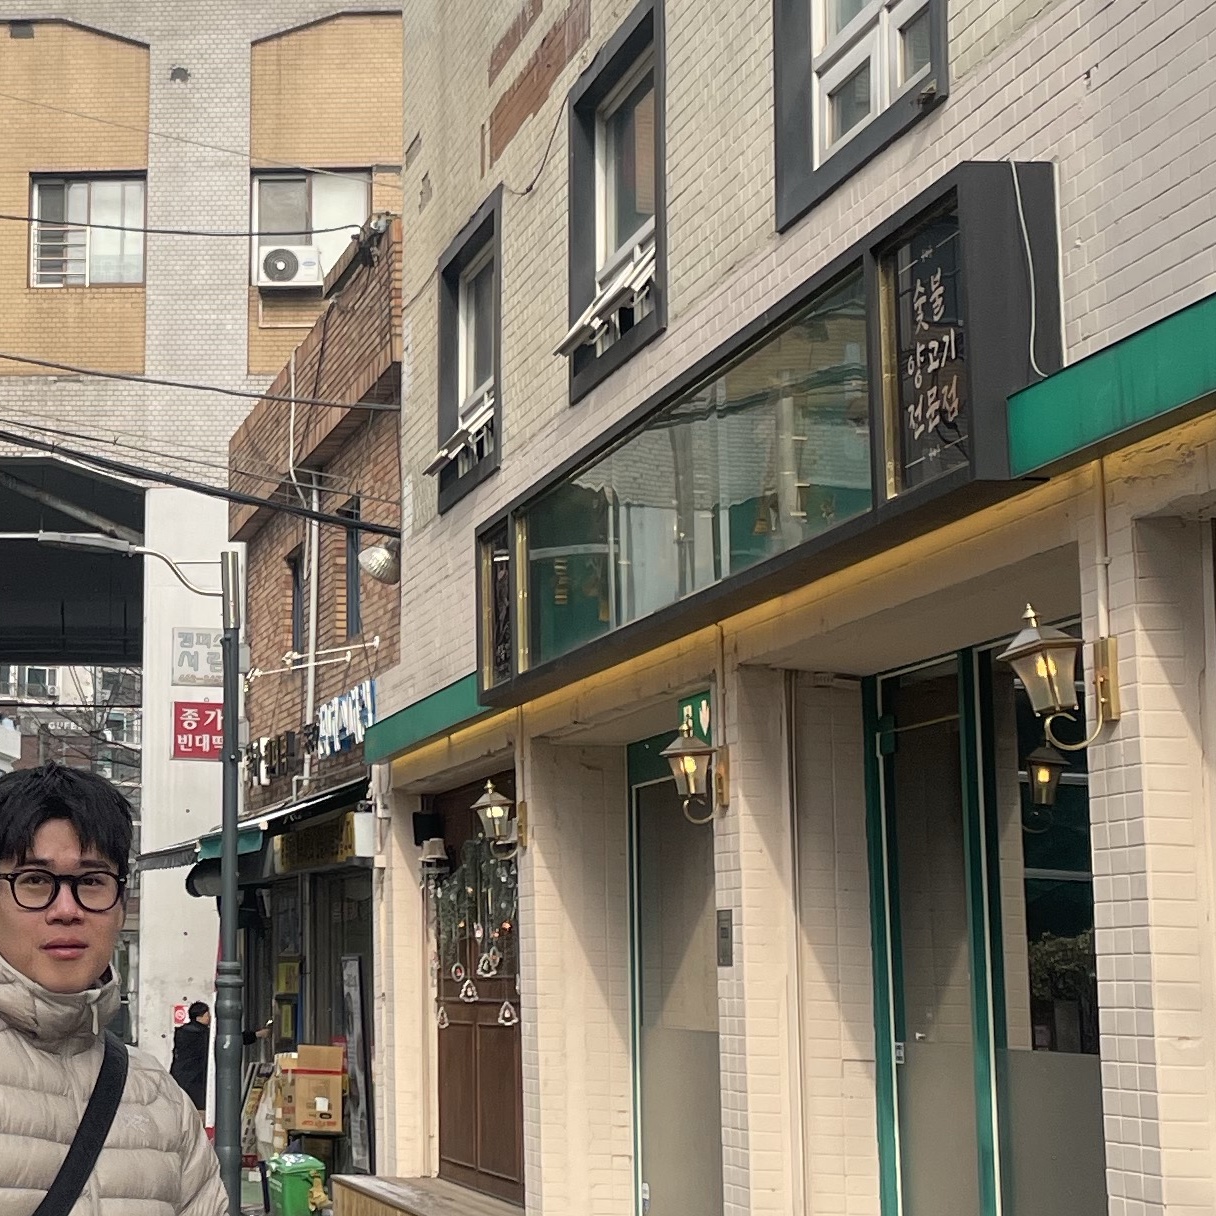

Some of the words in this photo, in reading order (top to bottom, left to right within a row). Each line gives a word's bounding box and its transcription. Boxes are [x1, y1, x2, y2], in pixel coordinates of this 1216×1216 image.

[913, 267, 945, 334] 숯불
[907, 328, 956, 389] 양고기
[907, 375, 959, 440] 전문점
[180, 708, 223, 731] 종가
